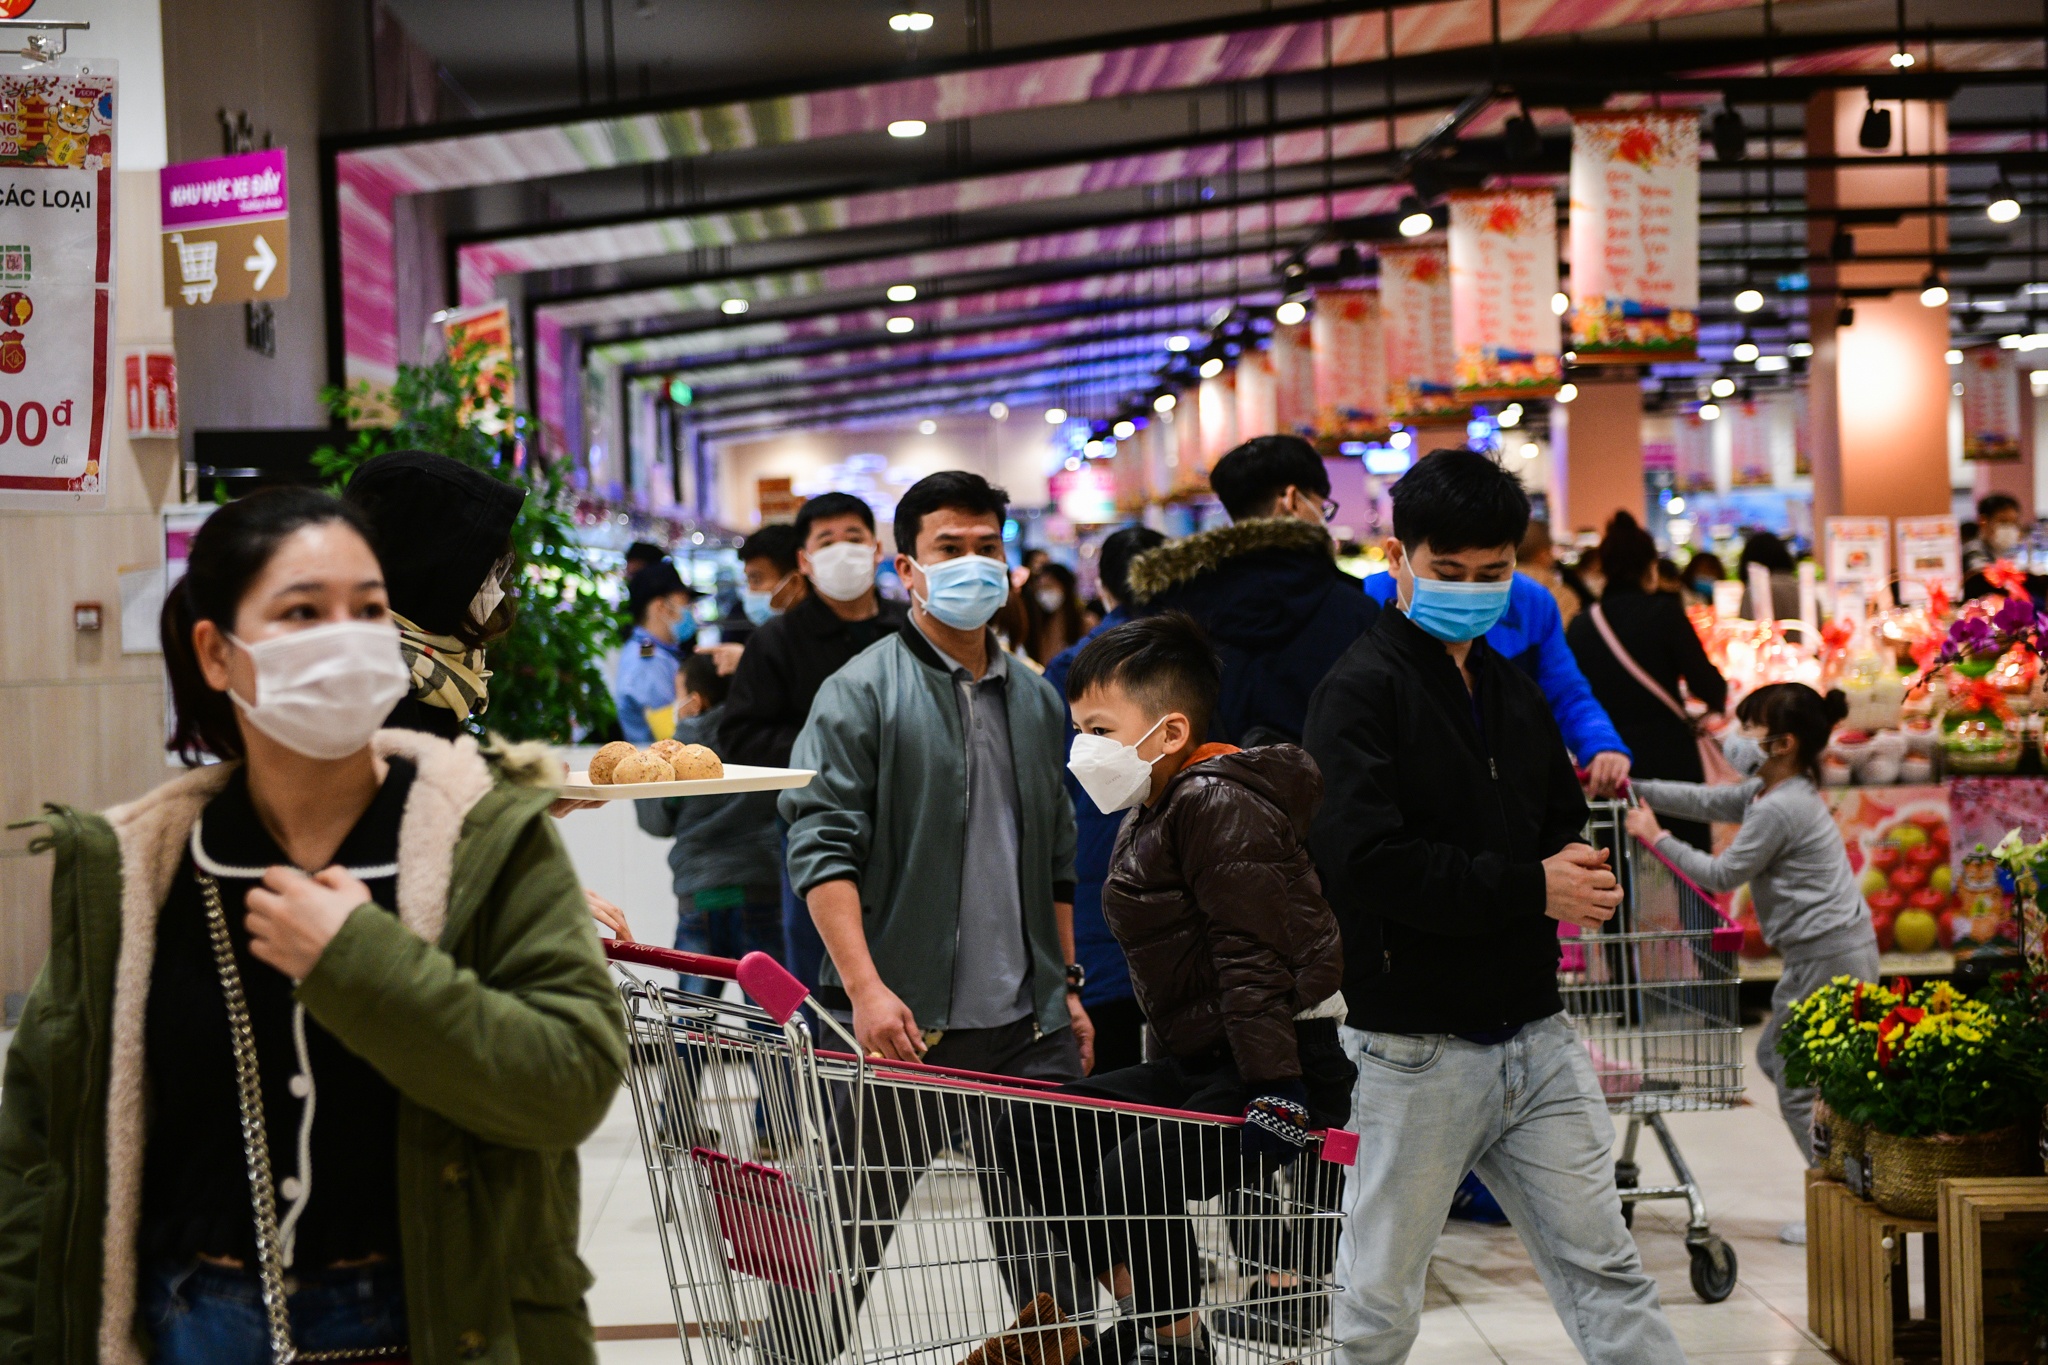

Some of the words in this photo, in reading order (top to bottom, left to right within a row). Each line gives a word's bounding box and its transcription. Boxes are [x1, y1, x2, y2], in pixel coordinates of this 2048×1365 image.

[42, 190, 91, 213] LOẠI
[169, 183, 200, 208] KHU
[231, 175, 251, 200] XE
[51, 454, 69, 465] /cái
